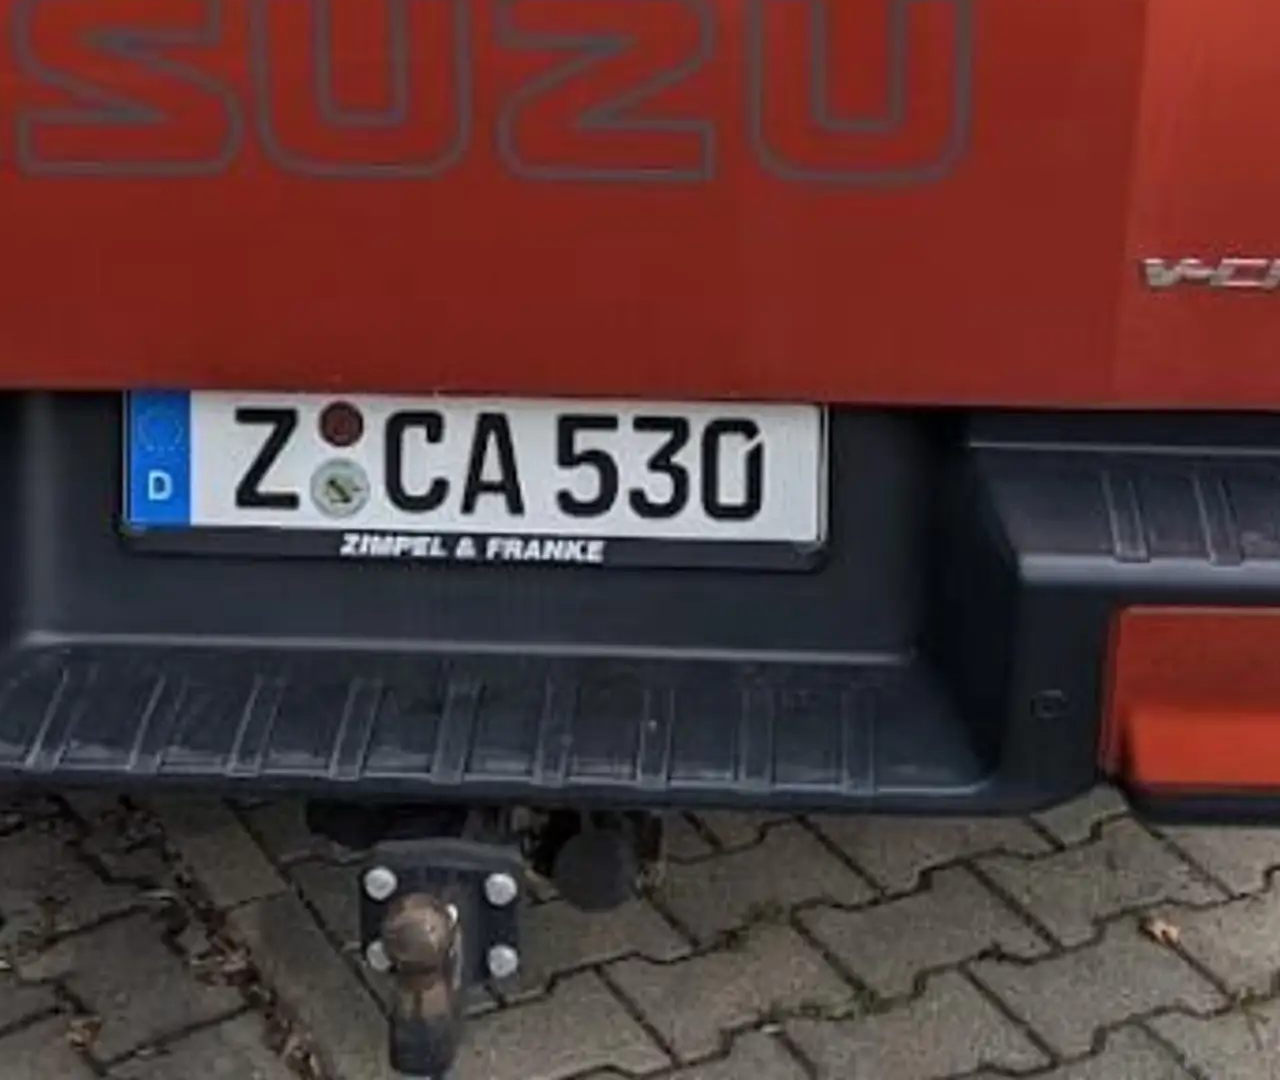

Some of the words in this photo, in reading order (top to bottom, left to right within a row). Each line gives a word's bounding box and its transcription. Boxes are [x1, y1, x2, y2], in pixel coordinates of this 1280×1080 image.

[234, 406, 301, 510] Z
[383, 409, 526, 517] CA
[554, 413, 766, 522] 530
[147, 469, 172, 500] D
[339, 532, 448, 557] ZIMPEL
[455, 536, 477, 559] &
[486, 538, 608, 563] FRANKE
